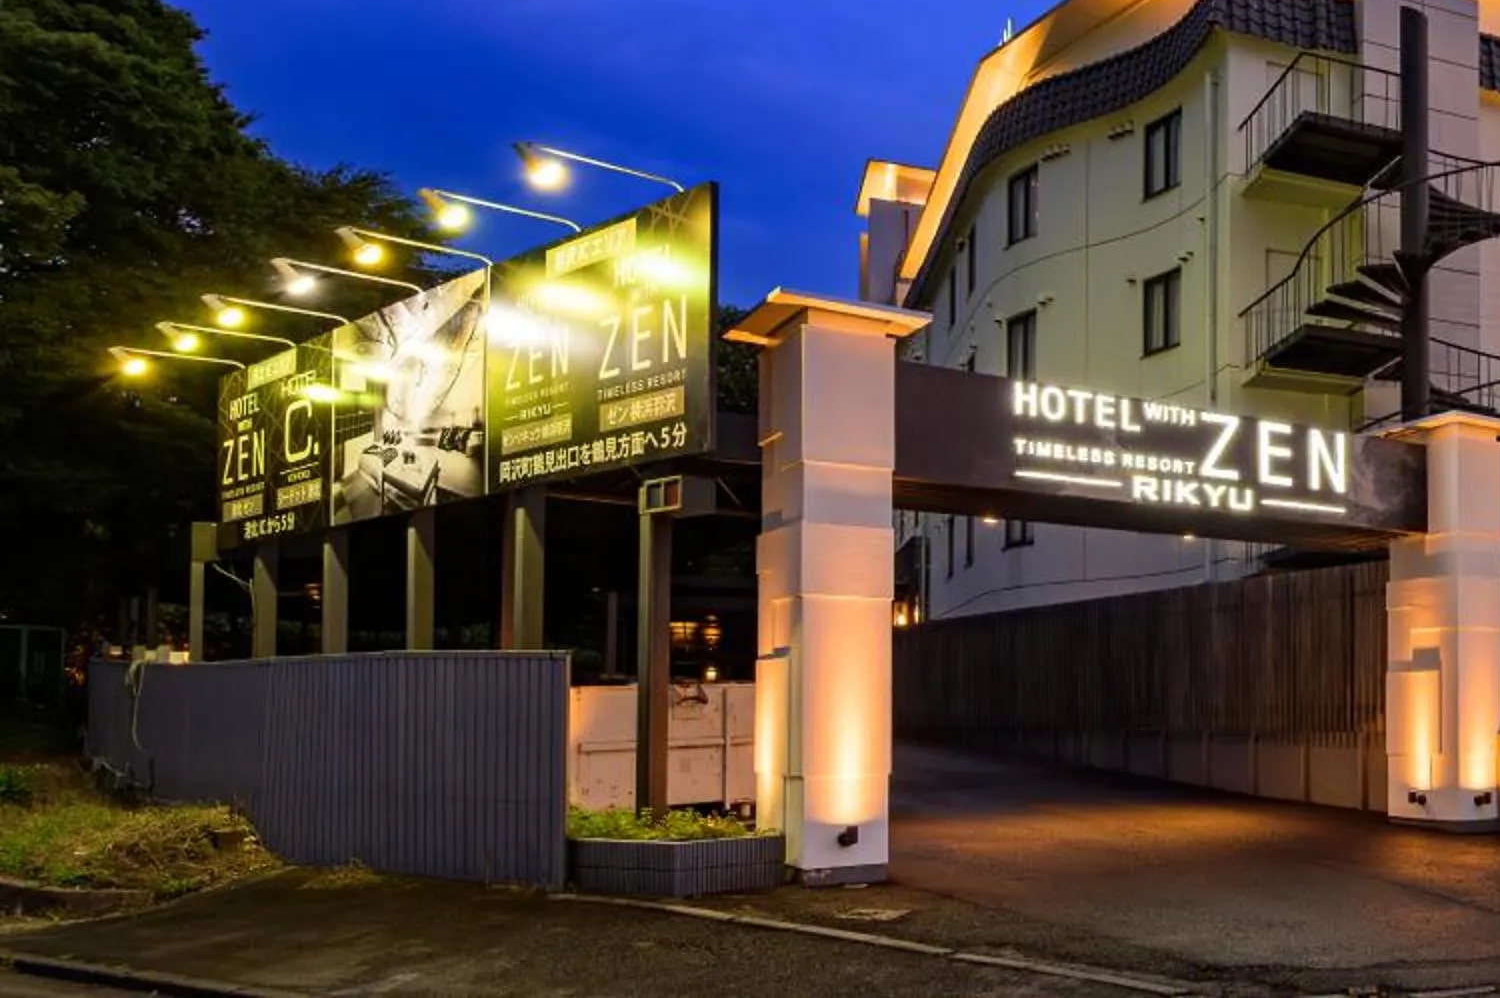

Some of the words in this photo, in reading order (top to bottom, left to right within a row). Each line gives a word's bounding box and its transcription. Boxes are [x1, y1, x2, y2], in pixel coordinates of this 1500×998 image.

[599, 293, 688, 379] ZEN
[229, 393, 260, 421] HOTEL
[281, 368, 317, 400] HOTE
[285, 399, 319, 463] C.
[1013, 381, 1140, 432] HOTEL
[1143, 402, 1195, 427] WITH
[1201, 410, 1346, 493] ZEN
[223, 429, 264, 484] ZEN
[1014, 439, 1115, 464] TIMELESS
[1121, 454, 1195, 476] RESORT
[1131, 477, 1253, 510] RIKYU
